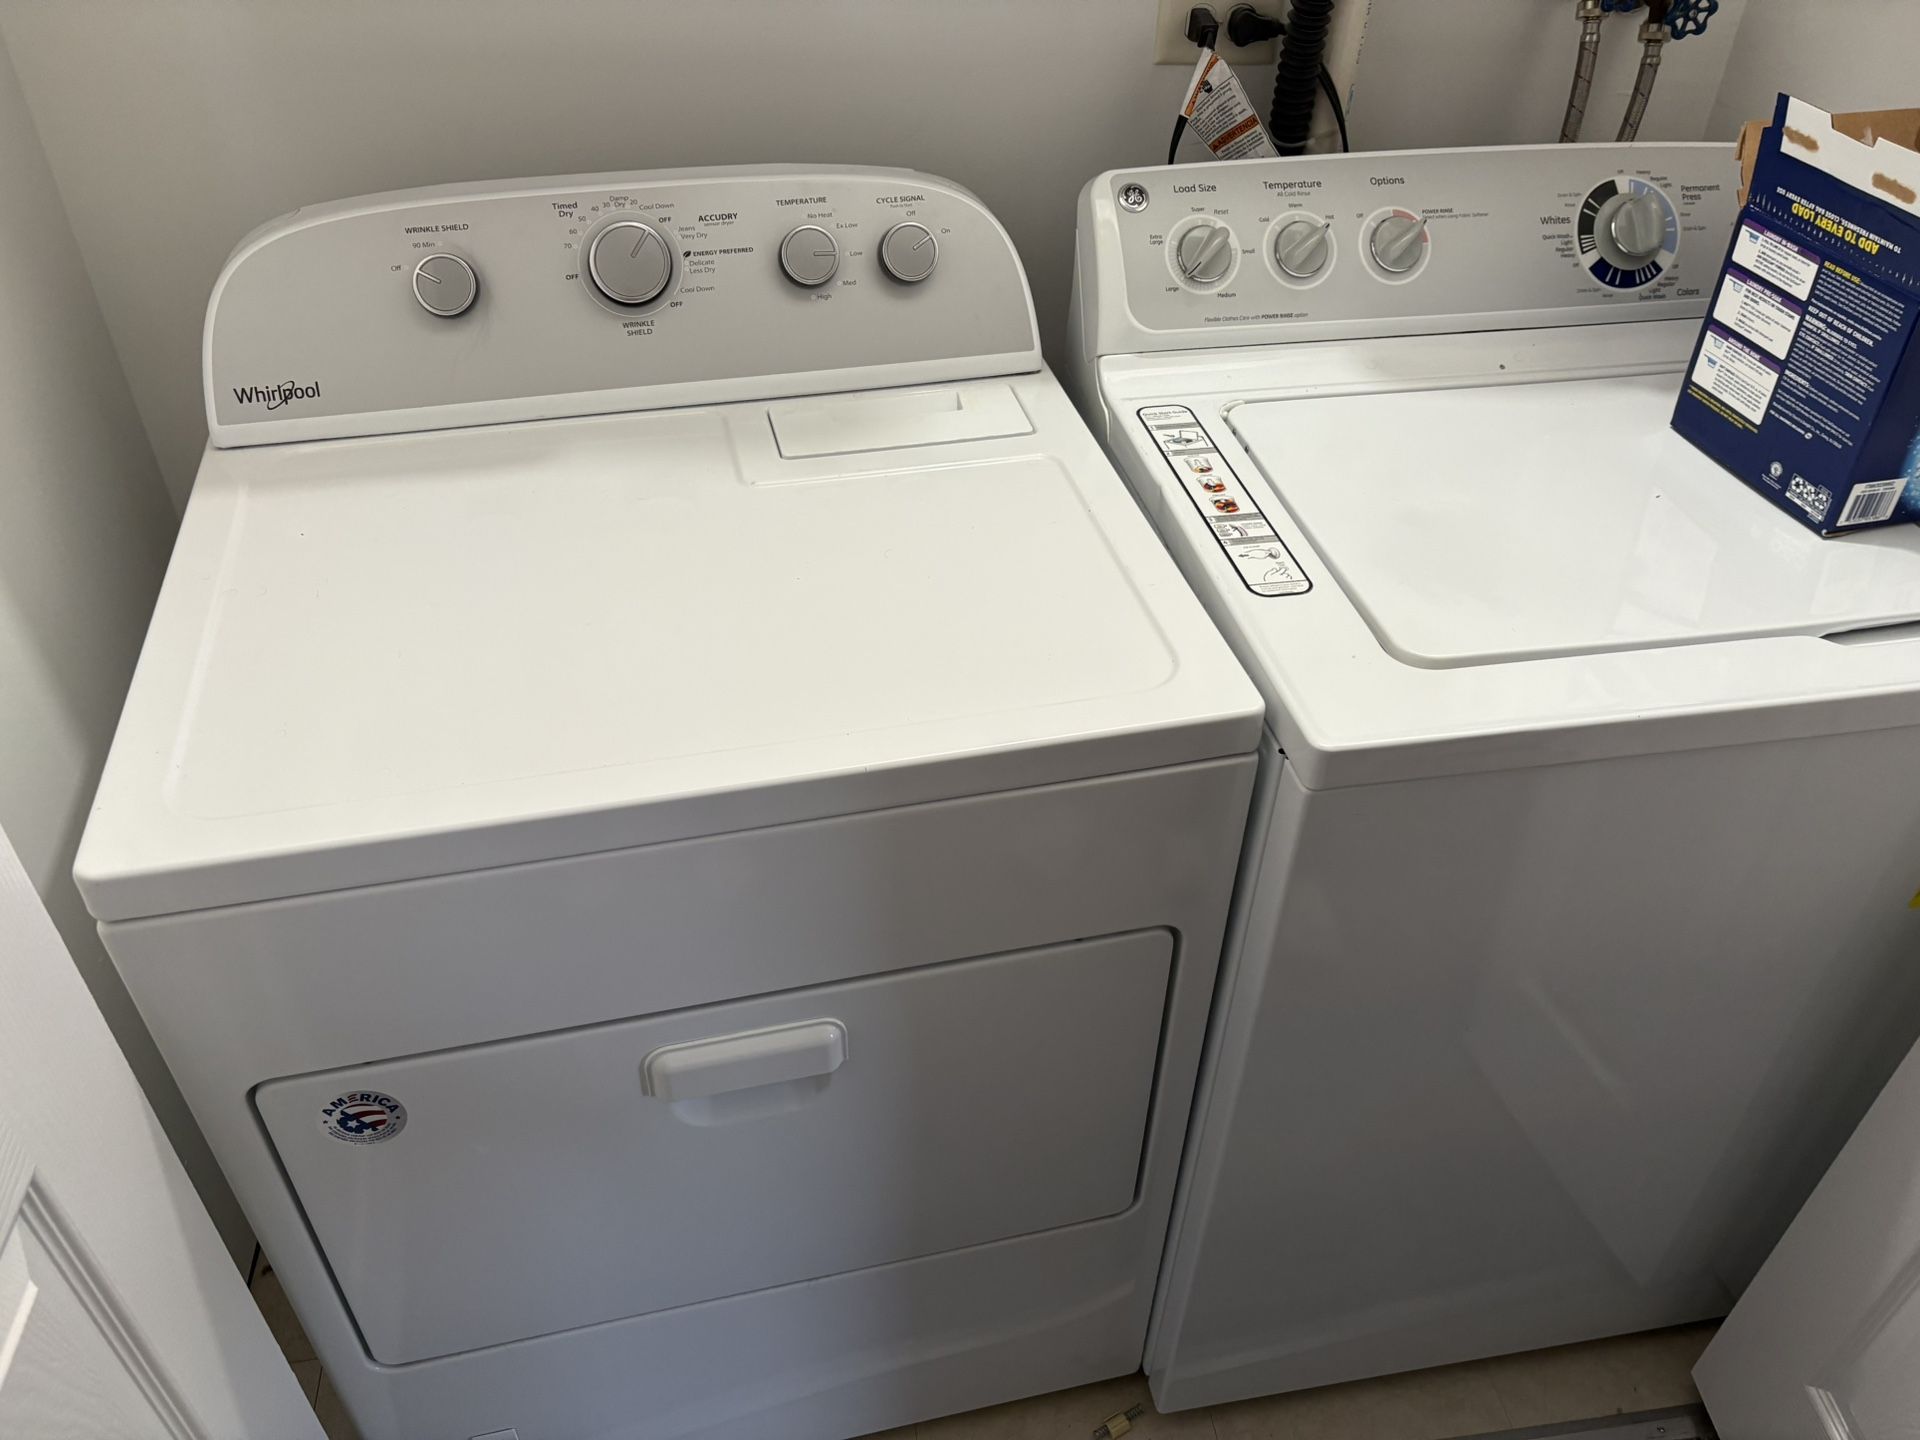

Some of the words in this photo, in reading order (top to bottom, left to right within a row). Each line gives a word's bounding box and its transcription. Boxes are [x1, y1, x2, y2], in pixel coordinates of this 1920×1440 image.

[1263, 180, 1322, 191] Temperature
[1369, 176, 1405, 187] Options
[1173, 184, 1196, 193] Load
[1198, 183, 1217, 192] Size
[1680, 184, 1721, 193] Permanent
[1776, 186, 1786, 195] USE
[776, 196, 827, 206] TEMPERATURE
[876, 196, 898, 204] CYCLE
[899, 194, 925, 202] SIGNAL
[1682, 193, 1702, 201] Press
[1785, 192, 1801, 202] EVERY
[552, 201, 578, 211] Timed
[1800, 198, 1815, 210] AFTER
[1791, 203, 1815, 222] LOAD
[1815, 205, 1825, 215] BAG
[698, 212, 738, 222] ACCUDRY
[1540, 215, 1572, 225] Whites
[1825, 211, 1840, 222] CLOSE
[405, 225, 440, 234] WRINKLE
[441, 223, 469, 232] SHIELD
[1815, 215, 1844, 237] EVERY
[1841, 218, 1869, 237] FRESHNESS,
[1844, 229, 1857, 244] TO
[1869, 233, 1894, 249] MAINTAIN
[1858, 237, 1879, 254] ADD
[1893, 245, 1901, 254] TO
[1676, 288, 1700, 297] Colors
[622, 320, 655, 328] WRINKLE
[1808, 305, 1819, 314] KEEP
[1818, 311, 1828, 319] OUT
[1833, 319, 1847, 331] REACH
[1852, 331, 1873, 347] CHILDREN.
[233, 380, 321, 410] Whirlpool
[322, 1093, 400, 1117] AMERICA
